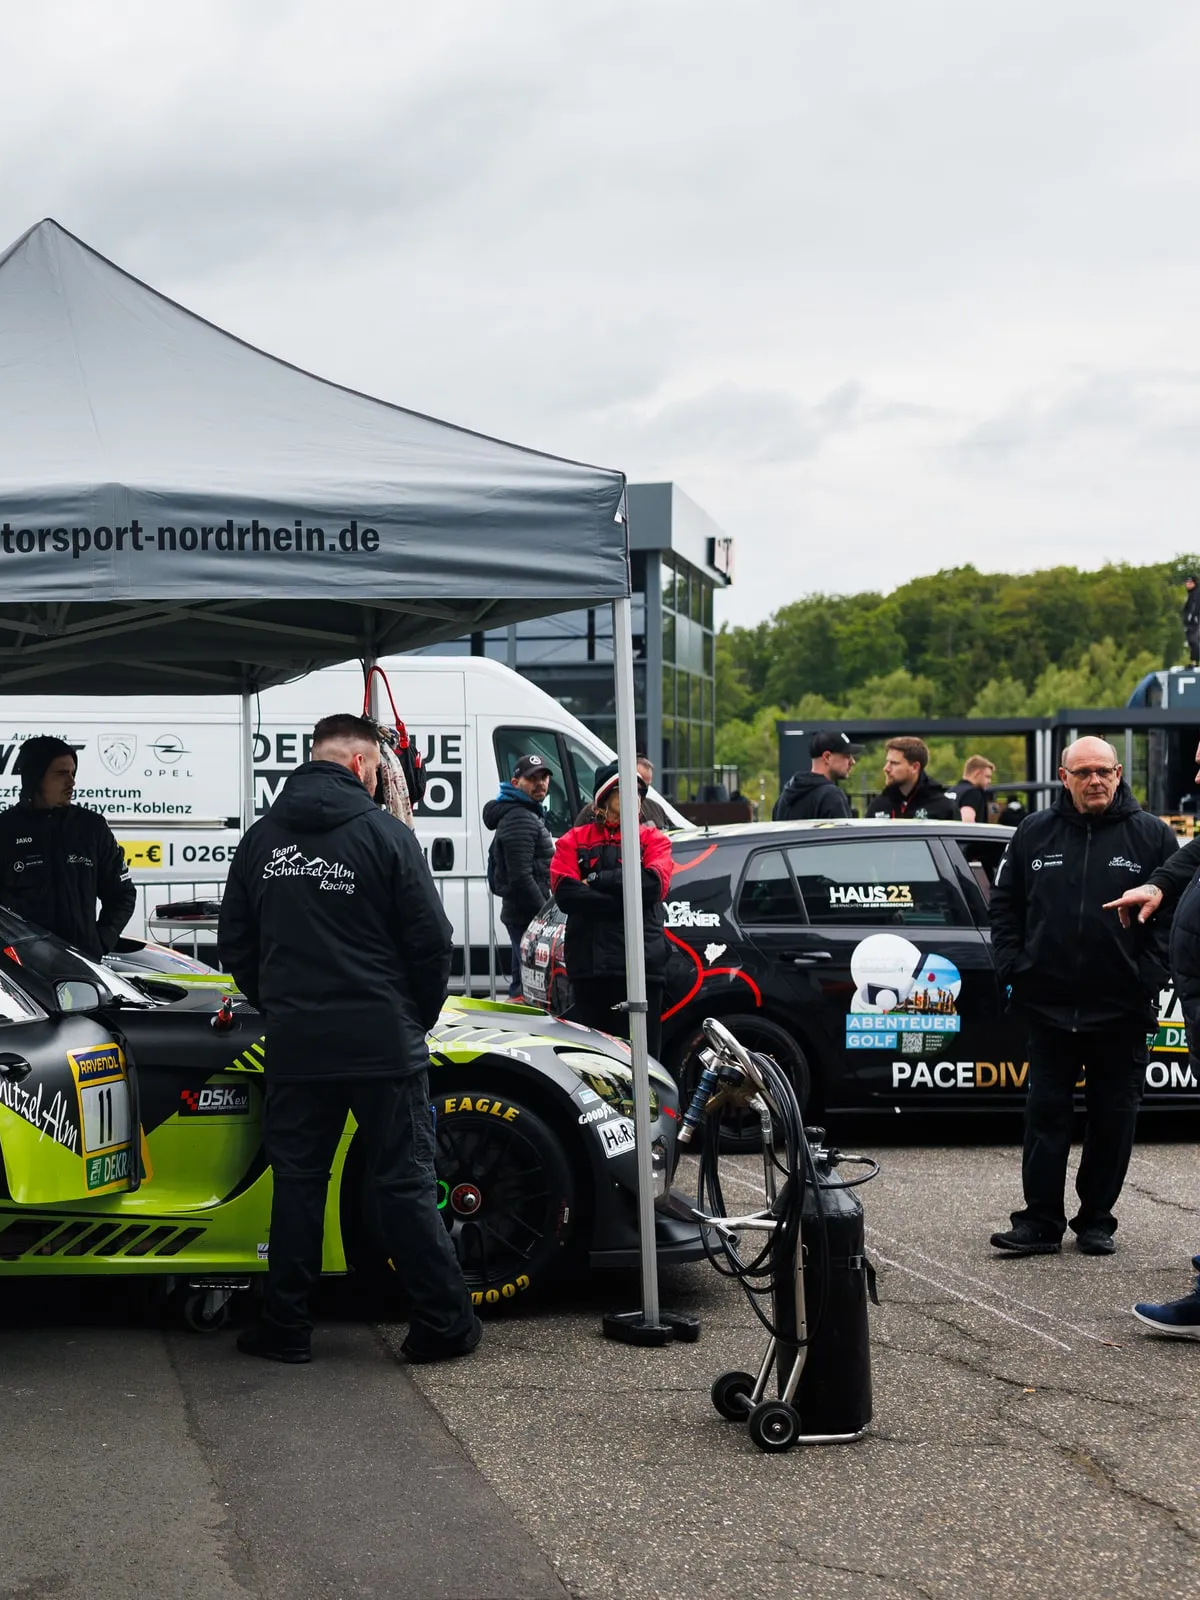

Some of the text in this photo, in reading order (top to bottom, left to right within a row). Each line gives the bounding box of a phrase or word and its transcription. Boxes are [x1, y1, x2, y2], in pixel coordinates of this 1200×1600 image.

[144, 769, 193, 777] OPEL
[15, 837, 32, 845] JAKO
[271, 844, 298, 859] Team
[319, 880, 356, 895] Racing
[829, 885, 913, 903] HAUS23
[849, 1016, 957, 1031] ABENTEUER
[849, 1033, 896, 1048] GOLF
[80, 1055, 120, 1075] RAVENOL
[198, 1088, 236, 1106] DSK
[98, 1087, 113, 1145] 11
[444, 1097, 520, 1122] EAGLE
